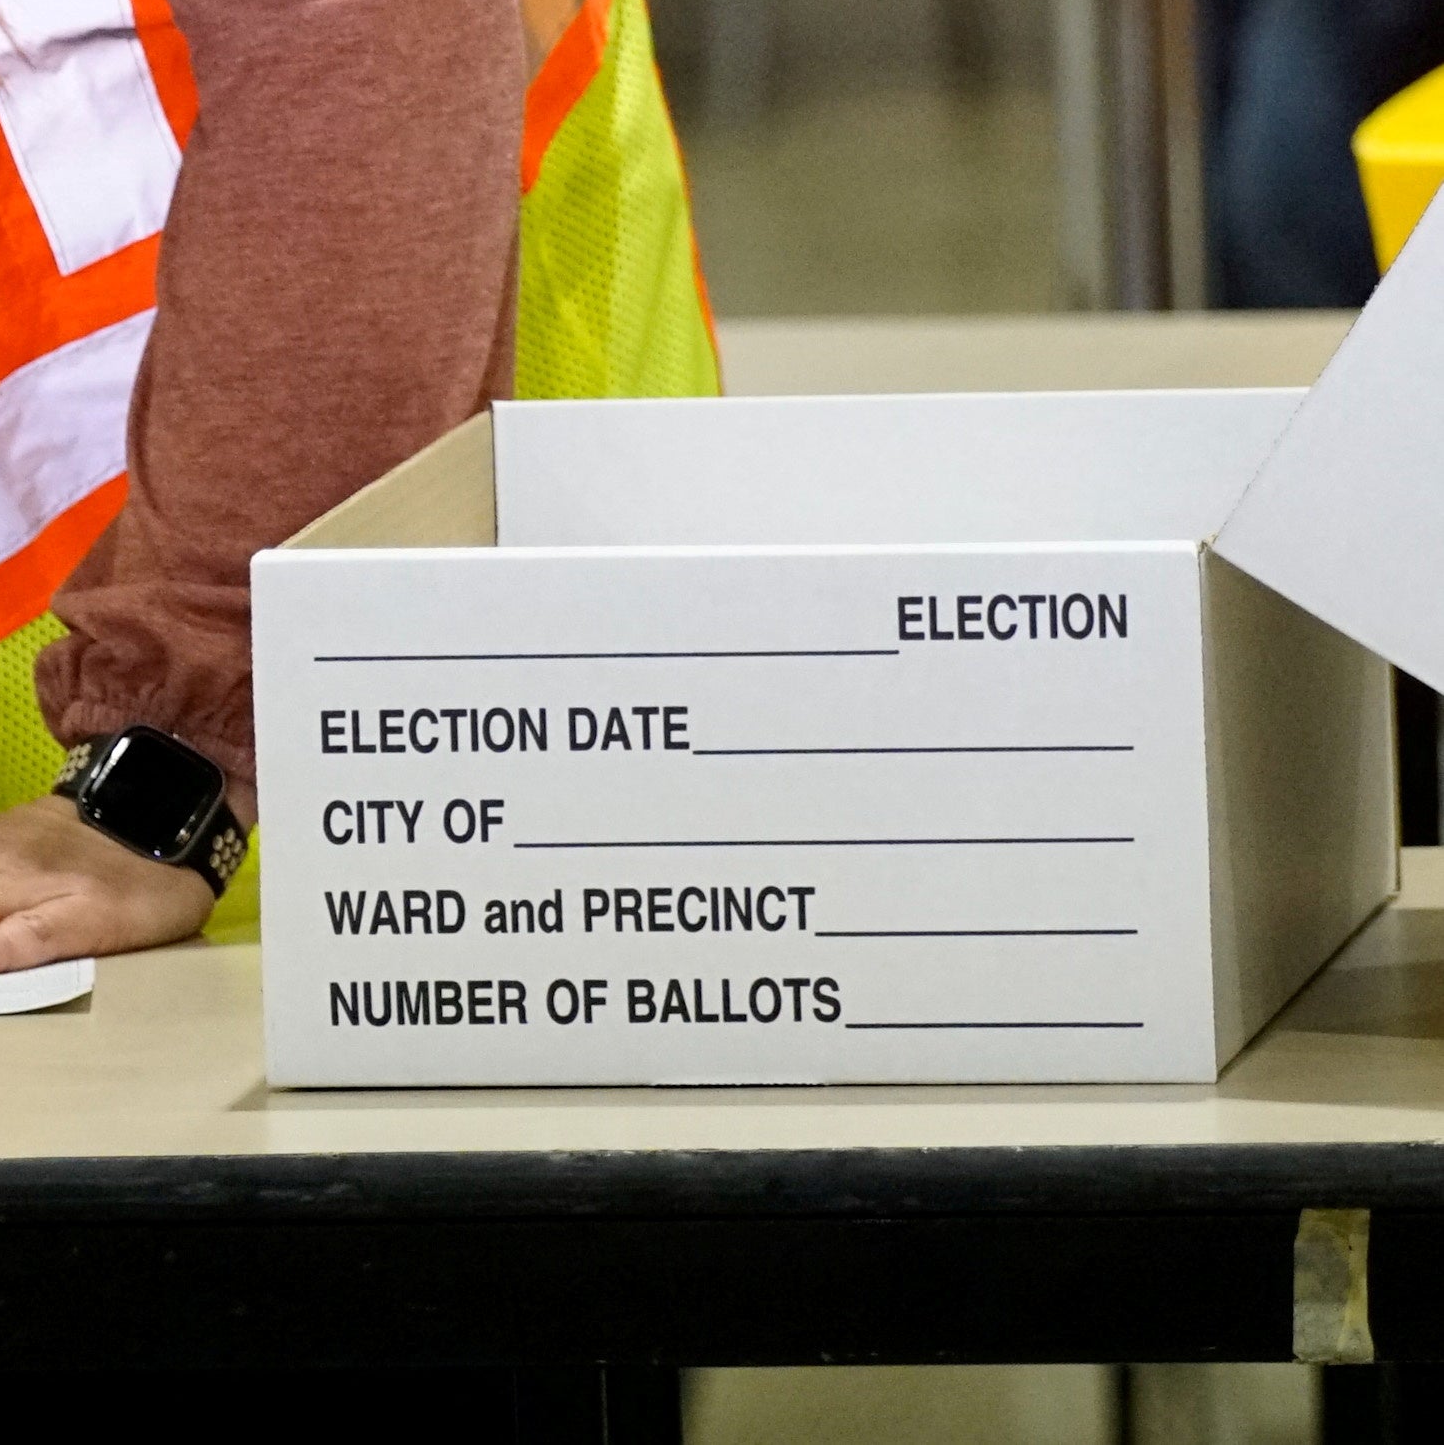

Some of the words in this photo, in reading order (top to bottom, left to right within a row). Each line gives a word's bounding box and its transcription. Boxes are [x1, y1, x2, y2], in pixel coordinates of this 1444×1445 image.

[897, 593, 1128, 641] ELECTION
[320, 707, 548, 754] ELECTION
[568, 706, 690, 751] DATE
[323, 800, 424, 845] CITY
[443, 798, 505, 844] OF
[324, 889, 466, 935] WARD
[484, 888, 564, 934] and
[583, 885, 816, 933] PRECINCT
[329, 980, 528, 1027] NUMBER
[546, 978, 608, 1025] OF
[627, 976, 842, 1024] BALLOTS
